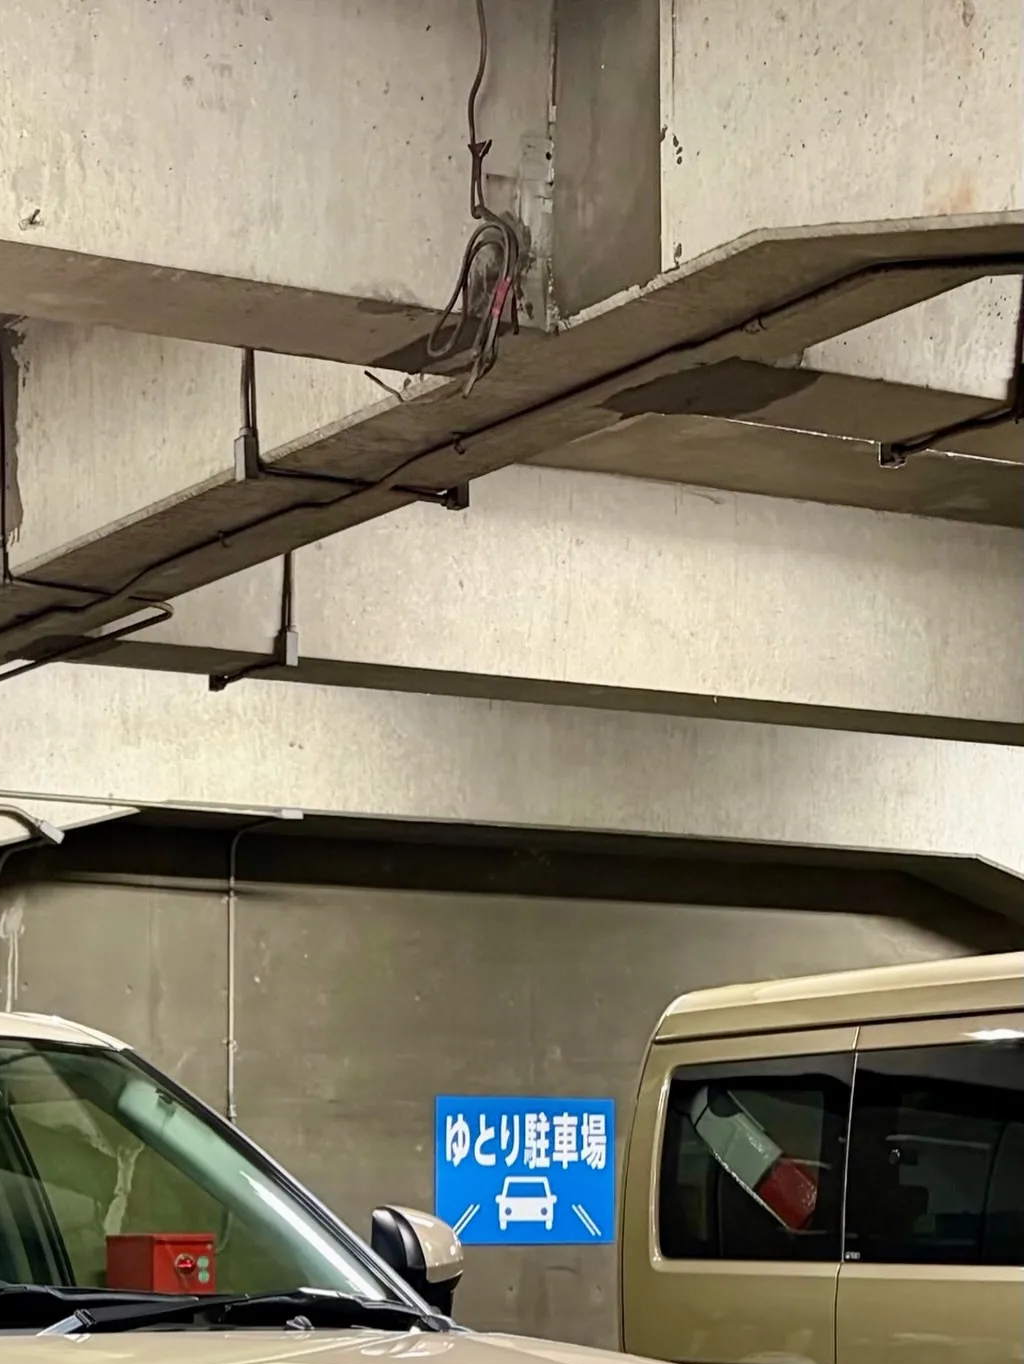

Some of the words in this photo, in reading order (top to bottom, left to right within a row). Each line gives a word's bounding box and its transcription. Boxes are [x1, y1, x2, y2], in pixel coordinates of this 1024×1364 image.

[446, 1112, 607, 1170] ゆとり駐車場
